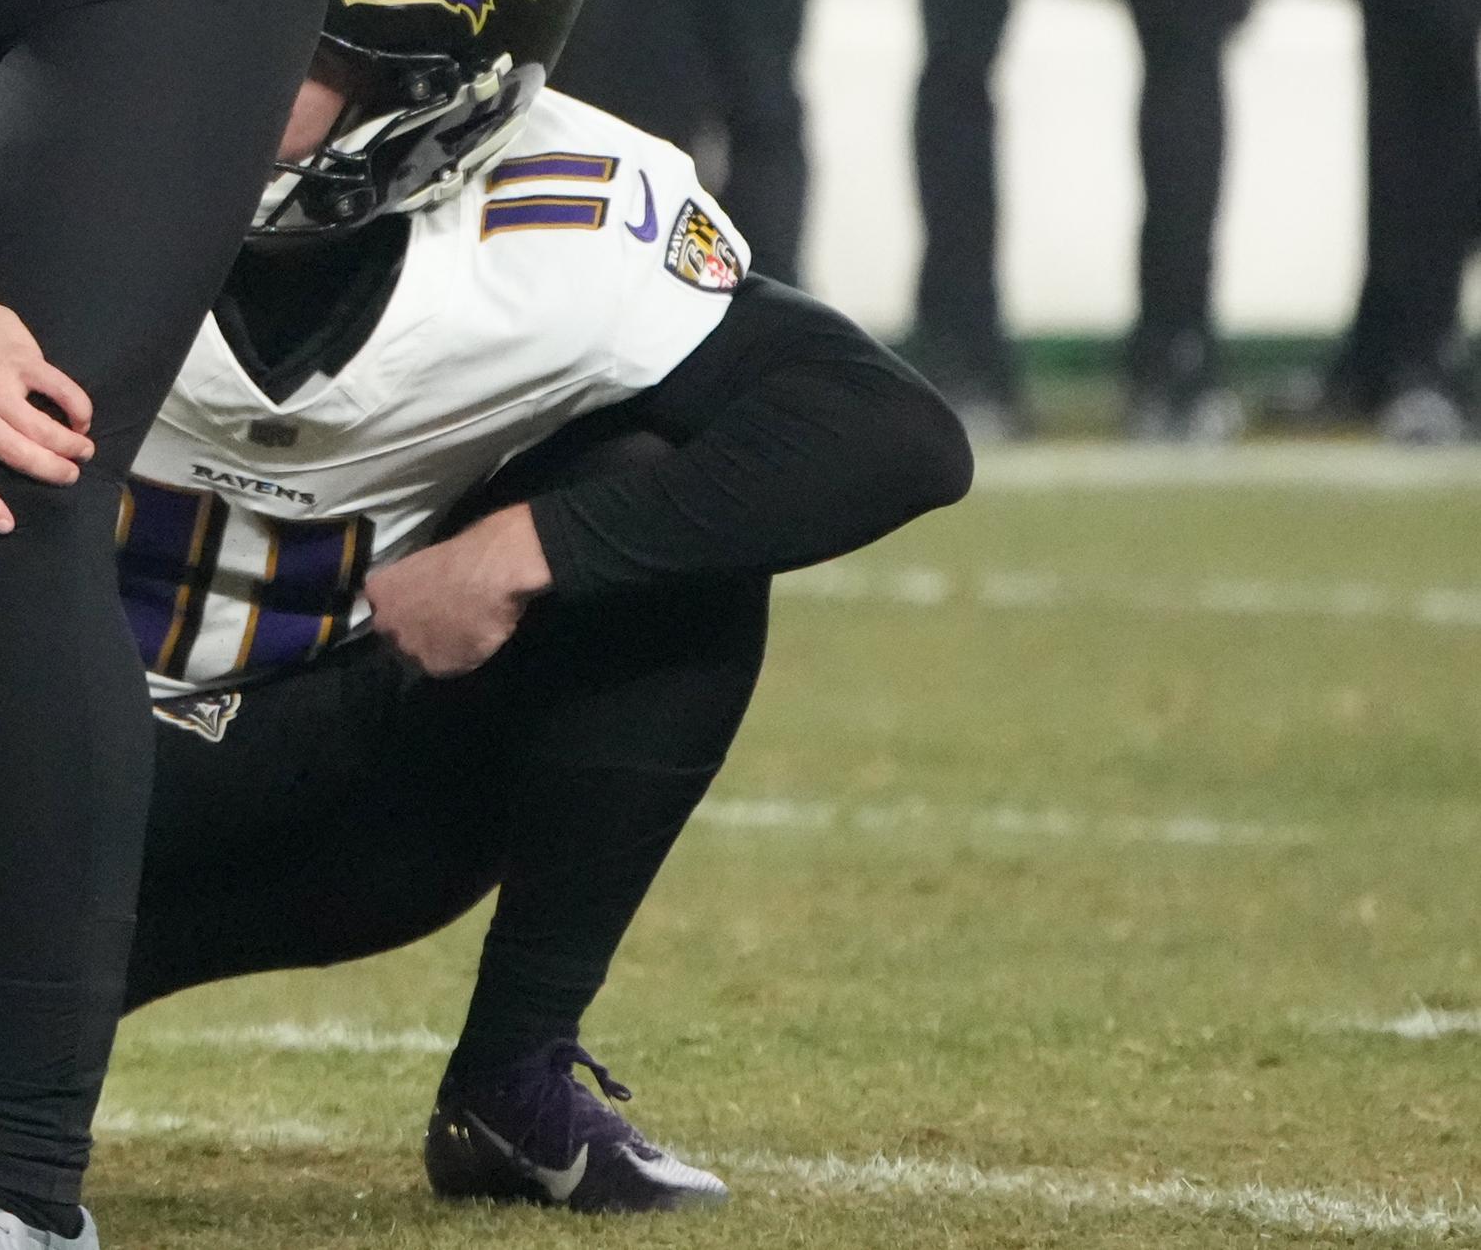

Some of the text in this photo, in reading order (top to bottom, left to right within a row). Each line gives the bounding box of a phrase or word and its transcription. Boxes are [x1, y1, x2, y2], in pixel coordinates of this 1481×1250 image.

[480, 152, 620, 242] 11
[668, 204, 694, 266] RAVENS
[191, 463, 316, 506] RAVENS
